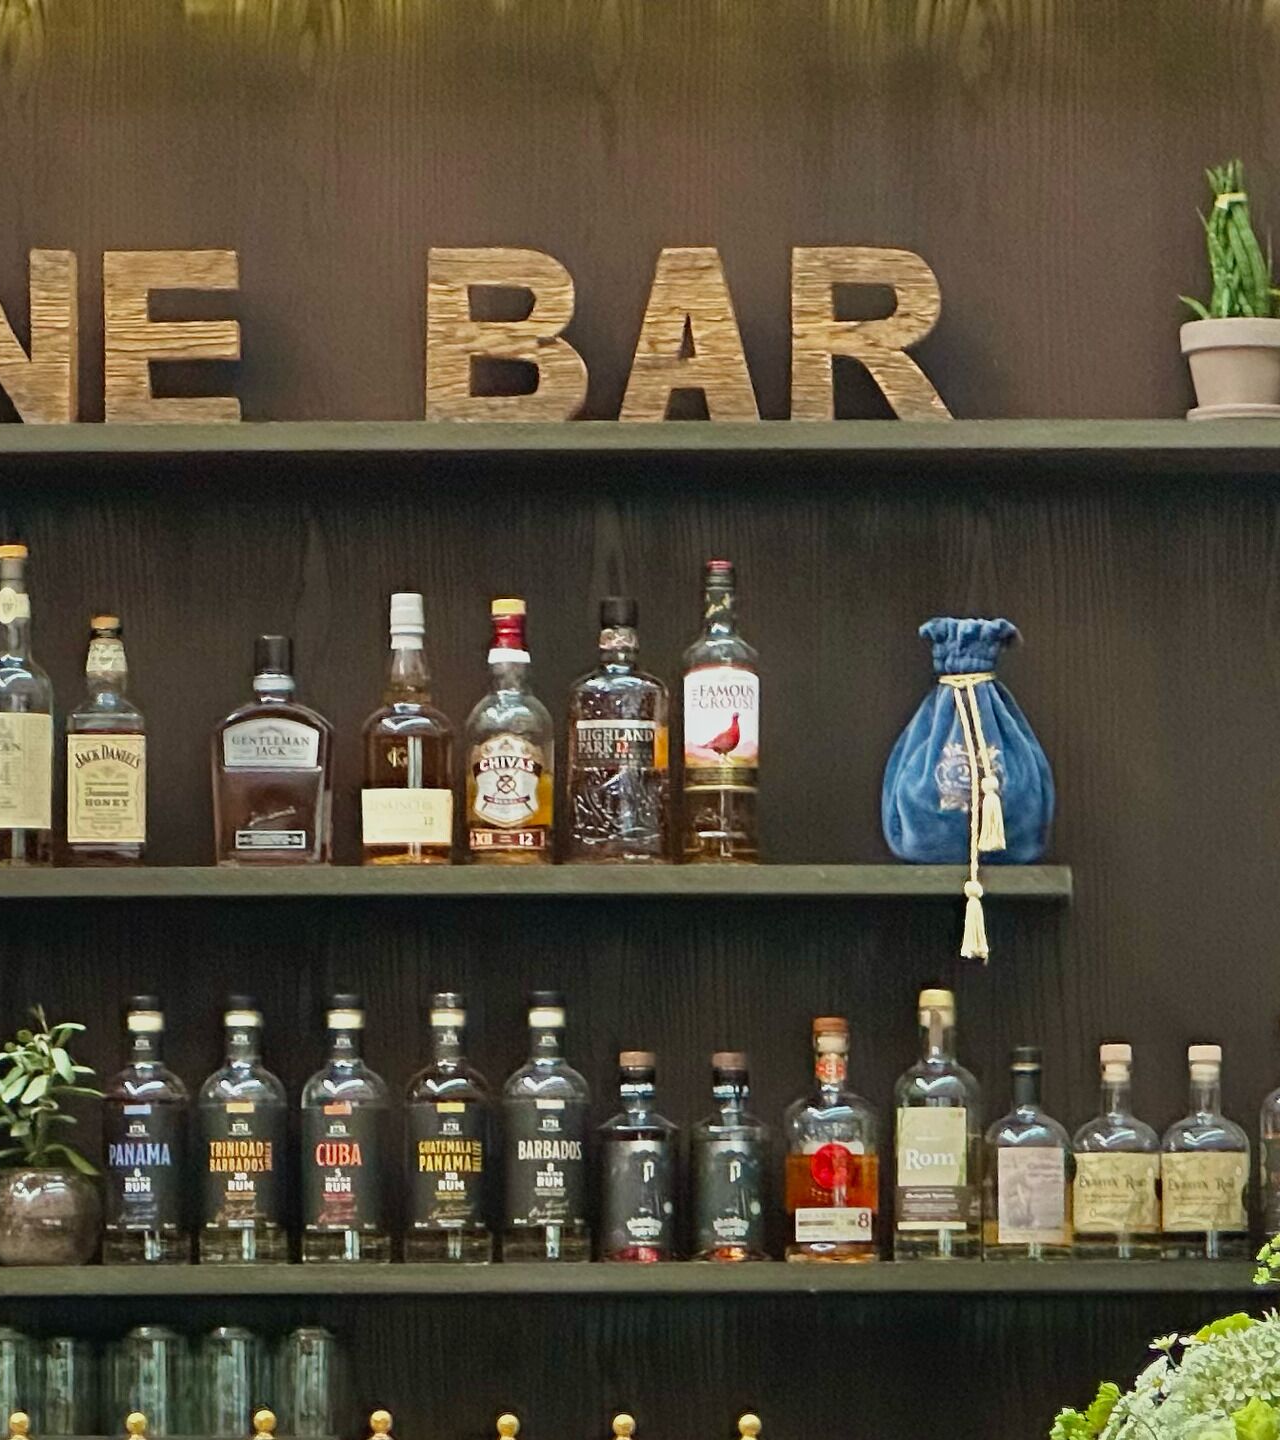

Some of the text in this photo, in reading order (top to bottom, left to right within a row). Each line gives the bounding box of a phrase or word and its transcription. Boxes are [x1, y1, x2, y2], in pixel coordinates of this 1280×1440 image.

[425, 246, 956, 427] BAR
[699, 684, 755, 697] FAMOUS
[231, 736, 310, 747] GENTLEMAN
[577, 728, 655, 742] HIGHLAND
[255, 746, 287, 756] JACK
[577, 742, 613, 753] PARK
[74, 749, 99, 769] JACK
[479, 756, 536, 772] CHIVAS
[84, 798, 130, 808] HONEY
[517, 832, 534, 846] 12
[209, 1141, 264, 1158] TRINIDAD
[418, 1140, 472, 1154] GUATEMALA
[517, 1140, 583, 1161] BARBADOS
[109, 1142, 172, 1167] PANAMA
[315, 1142, 363, 1167] CUBA
[904, 1147, 957, 1171] Rom
[209, 1157, 265, 1173] BARBADOS
[419, 1154, 472, 1173] PANAMA
[124, 1181, 151, 1193] RUM
[227, 1180, 254, 1191] RUM
[325, 1182, 352, 1193] RUM
[437, 1180, 466, 1191] RUM
[536, 1177, 564, 1188] RUM
[857, 1212, 870, 1229] 8
